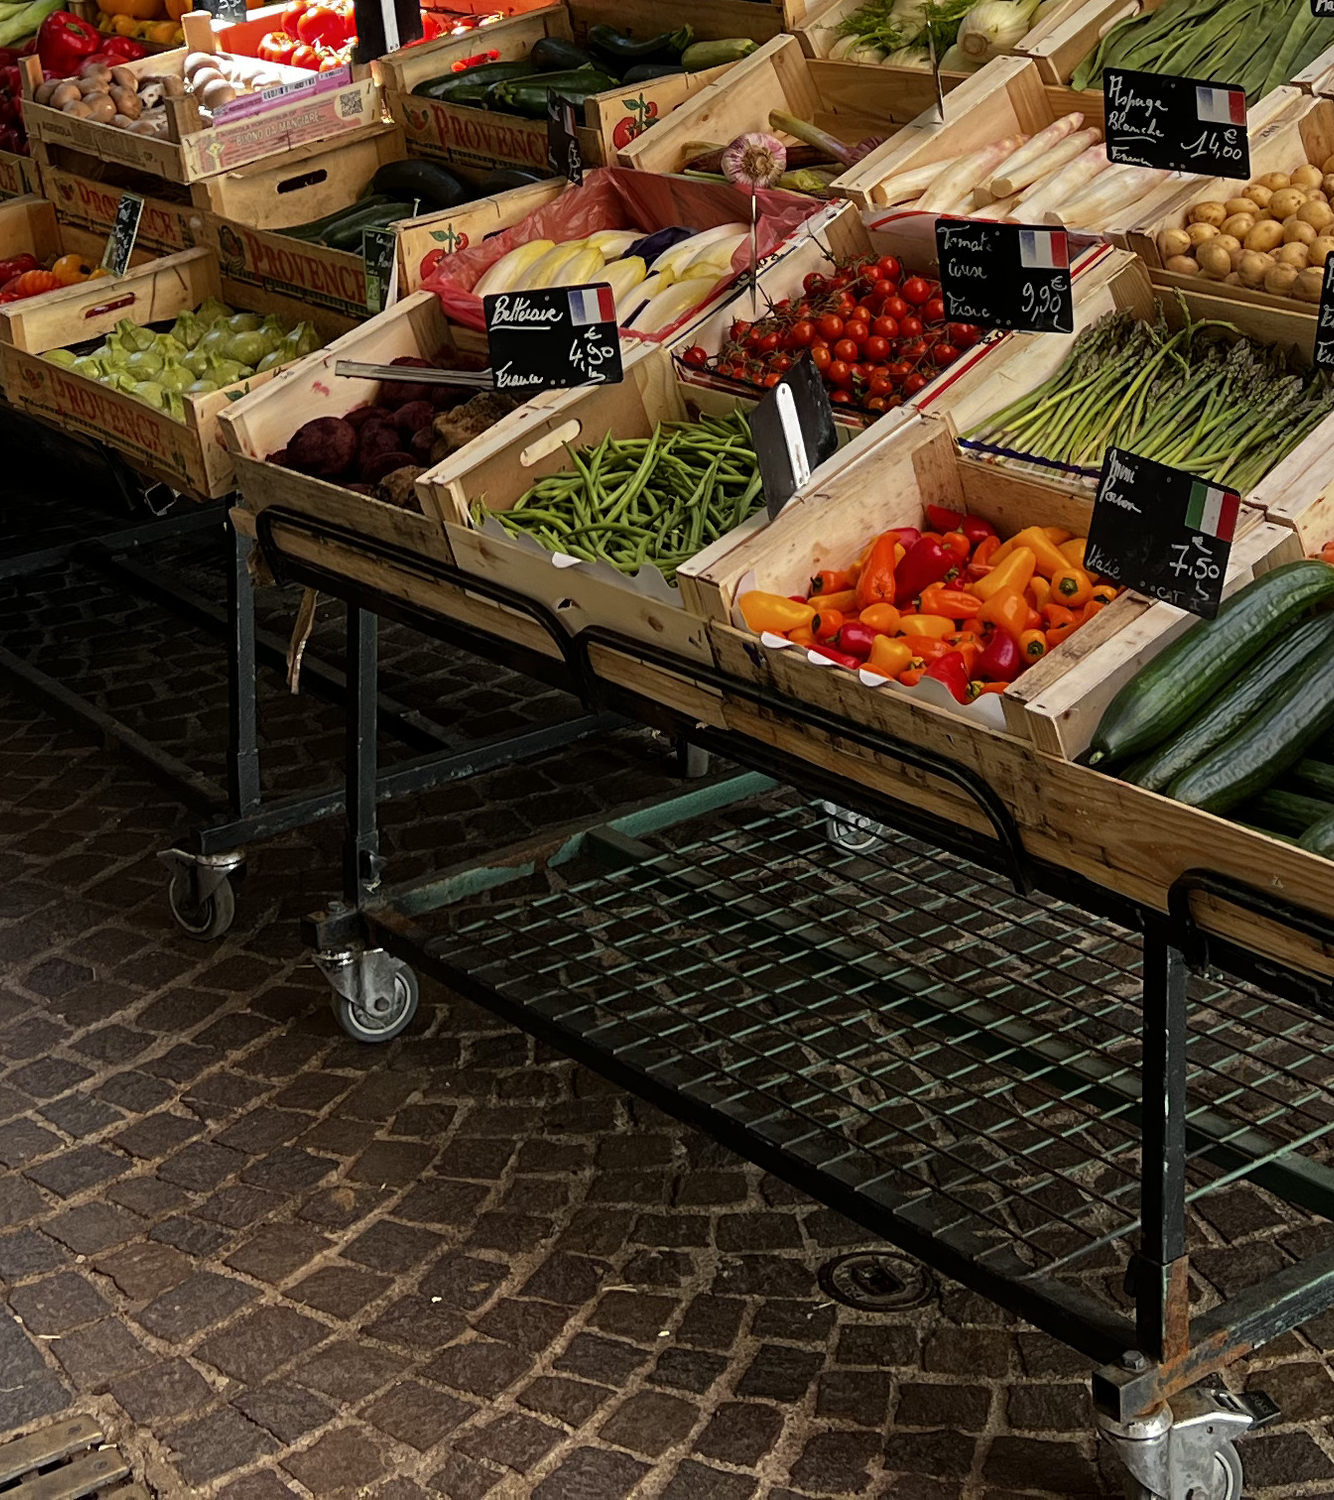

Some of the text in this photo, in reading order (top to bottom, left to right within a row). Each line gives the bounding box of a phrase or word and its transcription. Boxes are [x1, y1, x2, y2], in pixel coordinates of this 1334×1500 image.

[1108, 110, 1165, 138] Blanche
[1180, 130, 1243, 160] 14,00
[243, 230, 367, 305] PROVENCE
[1021, 282, 1062, 322] 9,90
[569, 339, 614, 372] 4,90
[47, 364, 166, 458] PROVENCE
[1169, 543, 1221, 579] 7,50
